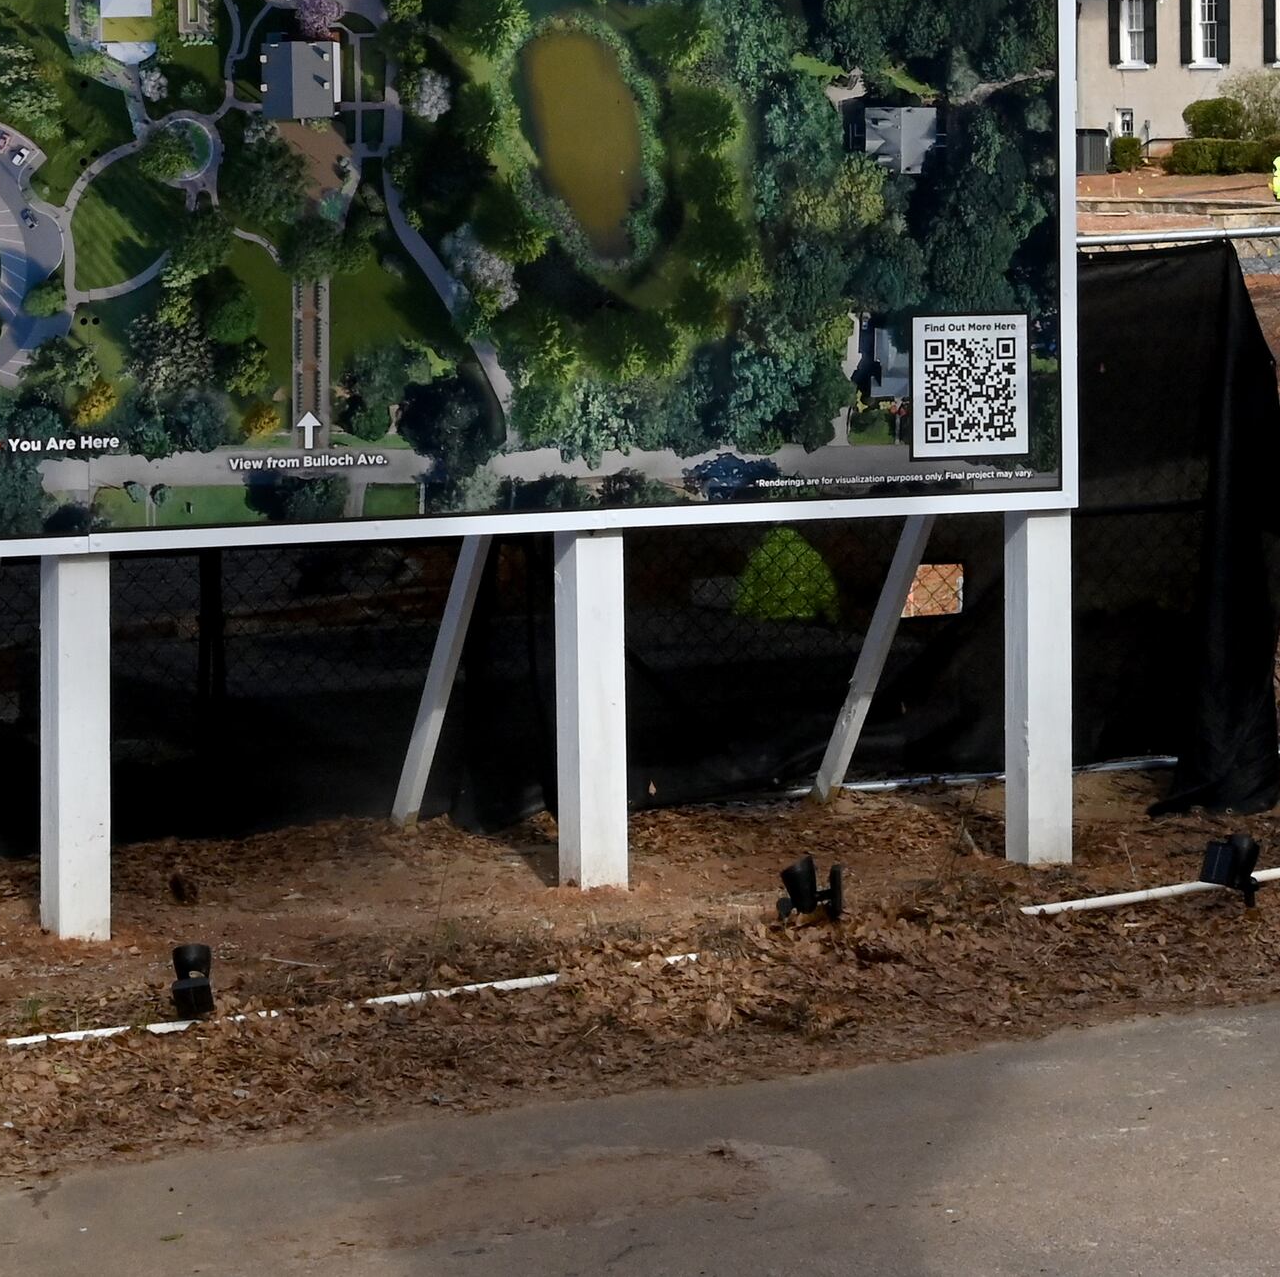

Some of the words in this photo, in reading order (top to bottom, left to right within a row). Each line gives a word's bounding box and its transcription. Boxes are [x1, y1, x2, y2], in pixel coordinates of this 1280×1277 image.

[924, 323, 946, 332] Find
[948, 323, 966, 332] Out
[968, 322, 992, 331] More
[994, 322, 1017, 331] Here
[8, 438, 41, 452] You
[45, 437, 76, 451] Are
[80, 435, 120, 450] Here
[229, 458, 263, 470] View
[267, 457, 300, 468] from
[303, 454, 353, 467] Bulloch
[357, 453, 388, 465] Ave.
[821, 476, 833, 485] for
[835, 475, 885, 484] visualization
[886, 473, 924, 483] purposes
[925, 472, 944, 482] only.
[945, 471, 965, 480] Final
[966, 470, 995, 480] project
[996, 470, 1013, 479] may
[1015, 469, 1034, 479] vary.
